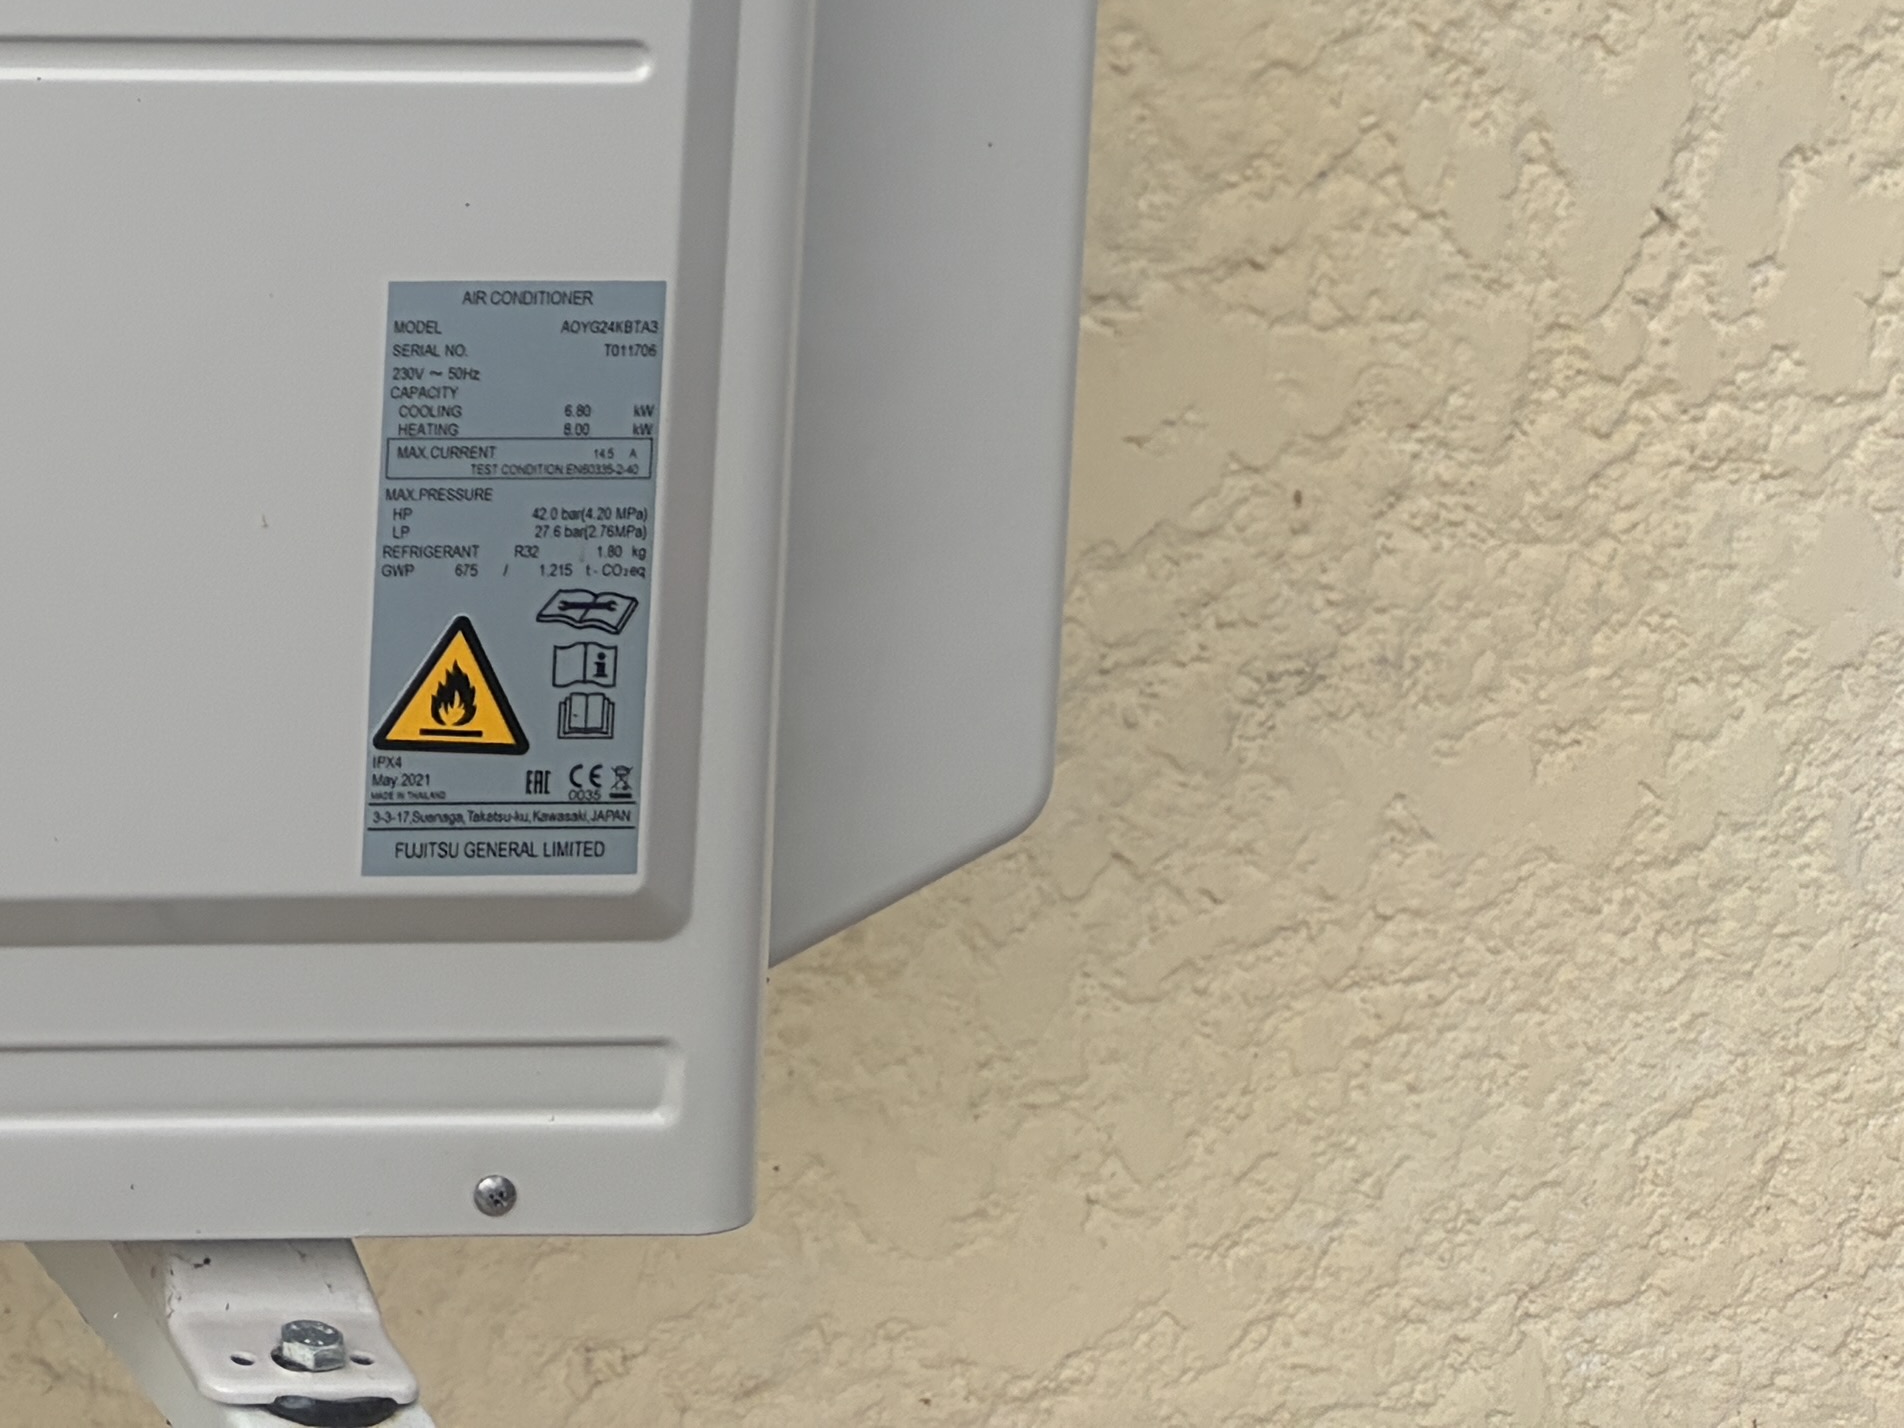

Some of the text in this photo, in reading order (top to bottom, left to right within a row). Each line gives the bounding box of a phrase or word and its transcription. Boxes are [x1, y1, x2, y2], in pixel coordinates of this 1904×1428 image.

[462, 290, 594, 305] AIR CONDITIONER
[393, 320, 442, 335] MODEL
[392, 343, 441, 357] SERIAL
[392, 367, 425, 381] 230V
[448, 366, 481, 381] 50Hz
[390, 386, 459, 400] CAPACITY
[398, 404, 655, 418] COOLING 6.80 kW
[398, 423, 460, 436] HEATING
[632, 423, 654, 436] kW
[629, 448, 638, 459] A
[471, 464, 498, 475] TEST
[393, 507, 413, 521] HP
[392, 525, 410, 539] LP
[382, 544, 647, 561] REFRIGERANT R32 1.80 kg
[381, 563, 415, 577] GWP
[455, 563, 479, 577] 675
[372, 756, 402, 769] IPX4
[372, 773, 430, 788] May 2021
[395, 841, 606, 859] FUJITSU GENERAL LIMITED
